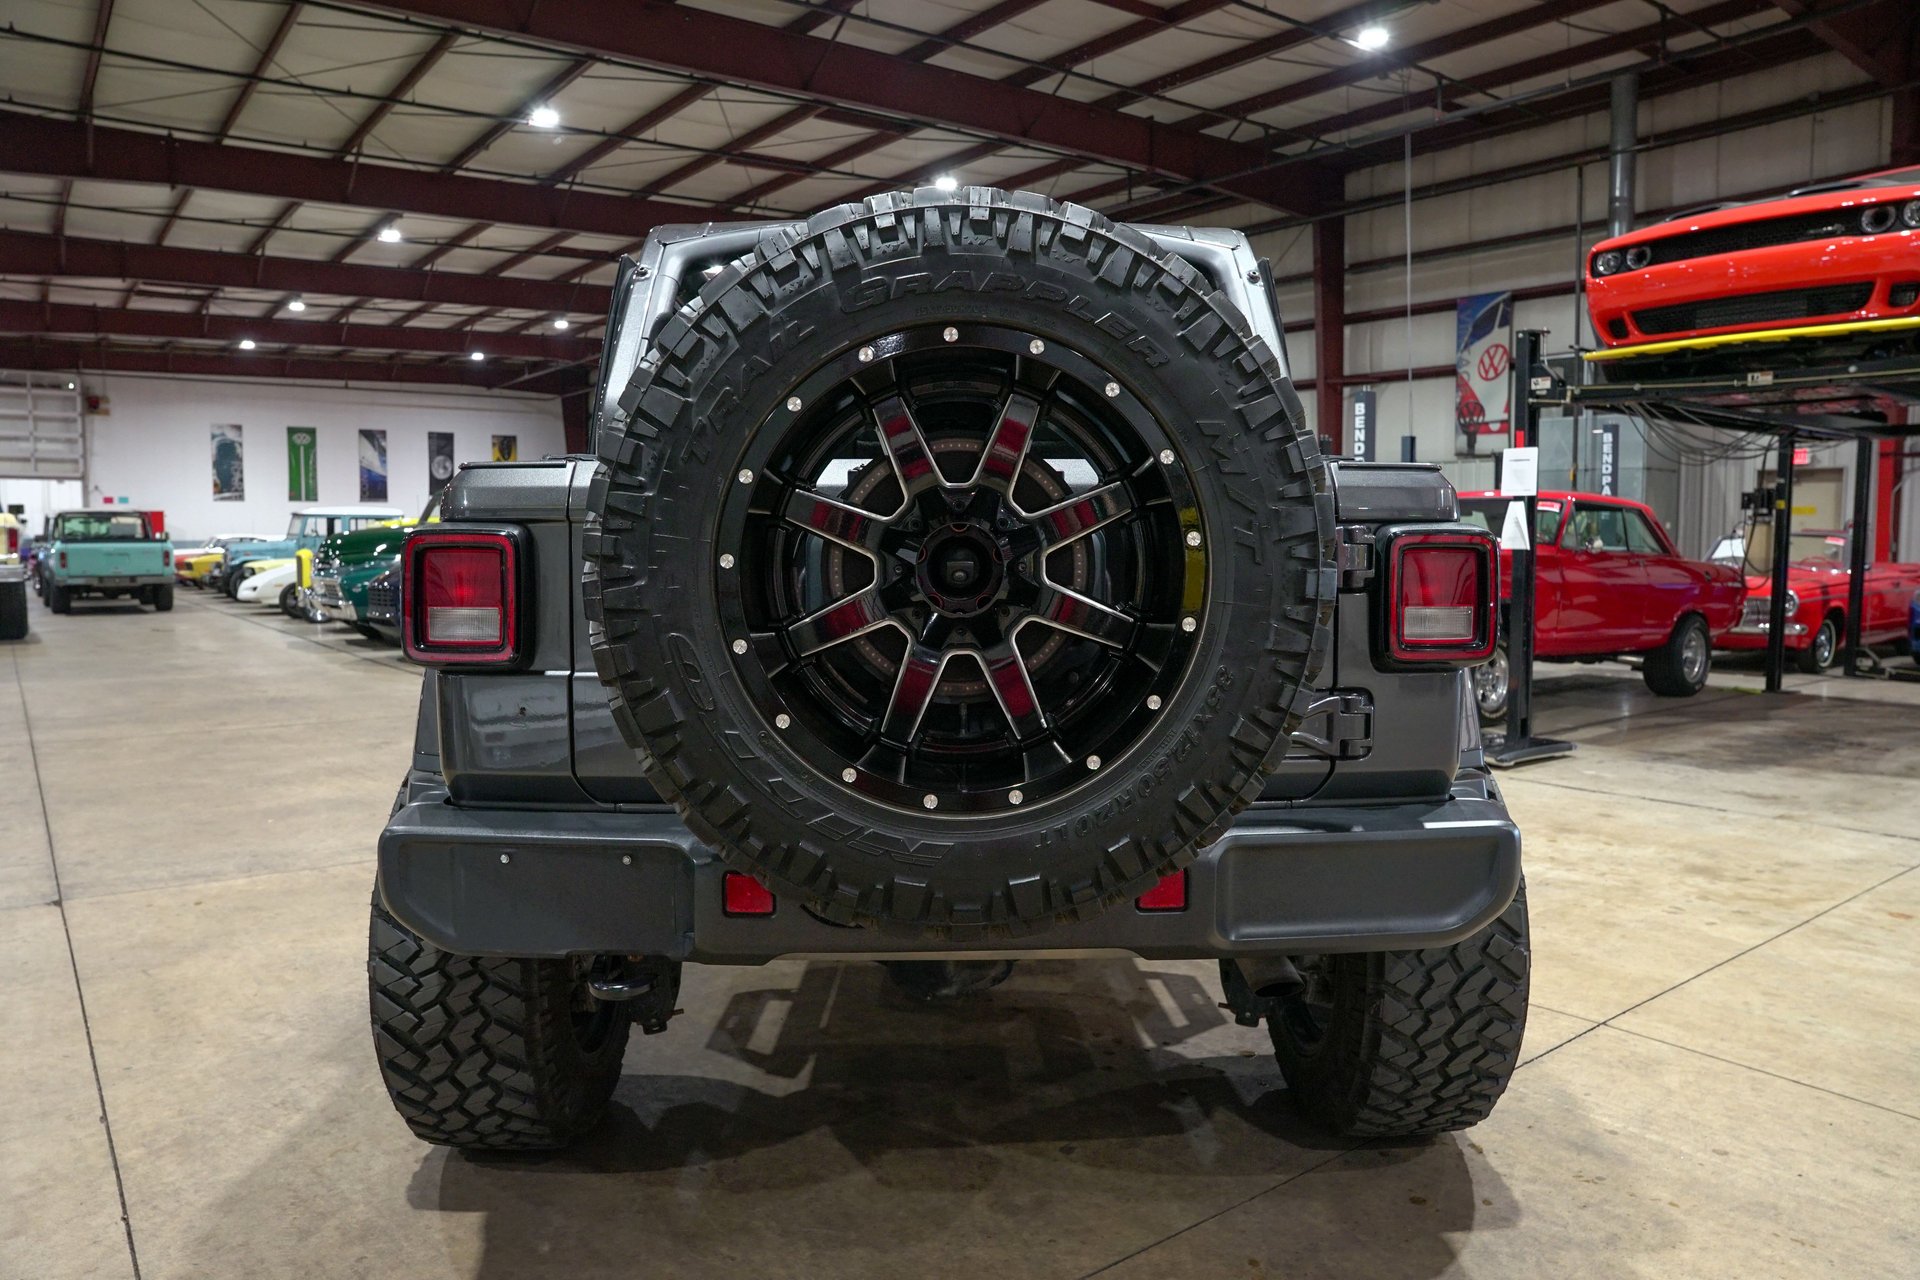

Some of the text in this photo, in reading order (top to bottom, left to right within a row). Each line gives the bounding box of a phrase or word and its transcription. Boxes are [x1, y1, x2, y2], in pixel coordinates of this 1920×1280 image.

[679, 319, 816, 465] TRAIL
[841, 269, 1171, 368] GRAPPLER
[664, 632, 954, 867] NITTO
